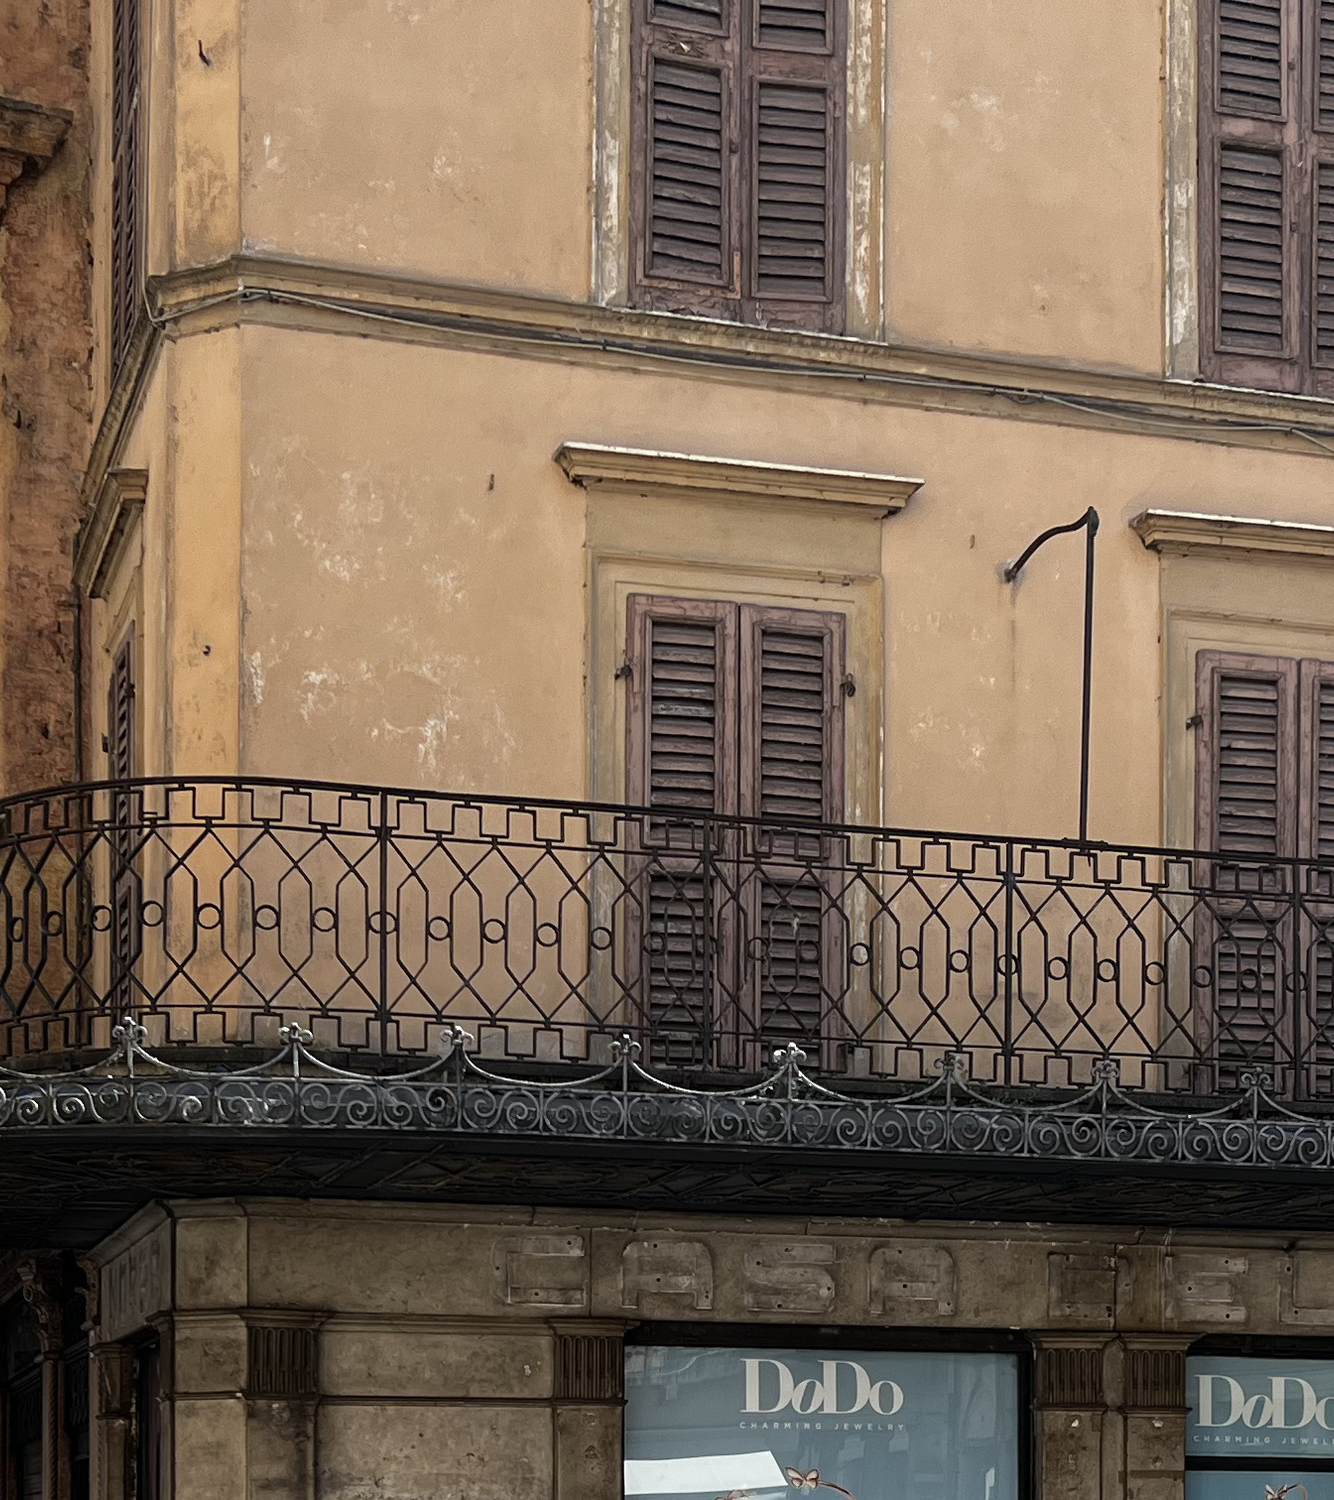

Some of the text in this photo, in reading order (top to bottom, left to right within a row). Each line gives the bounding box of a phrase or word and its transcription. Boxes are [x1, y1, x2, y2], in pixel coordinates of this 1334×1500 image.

[492, 1234, 955, 1315] CASA
[740, 1358, 904, 1416] DoDo
[739, 1422, 905, 1431] CHARMING JEWELRY
[1193, 1435, 1271, 1444] CHARMING
